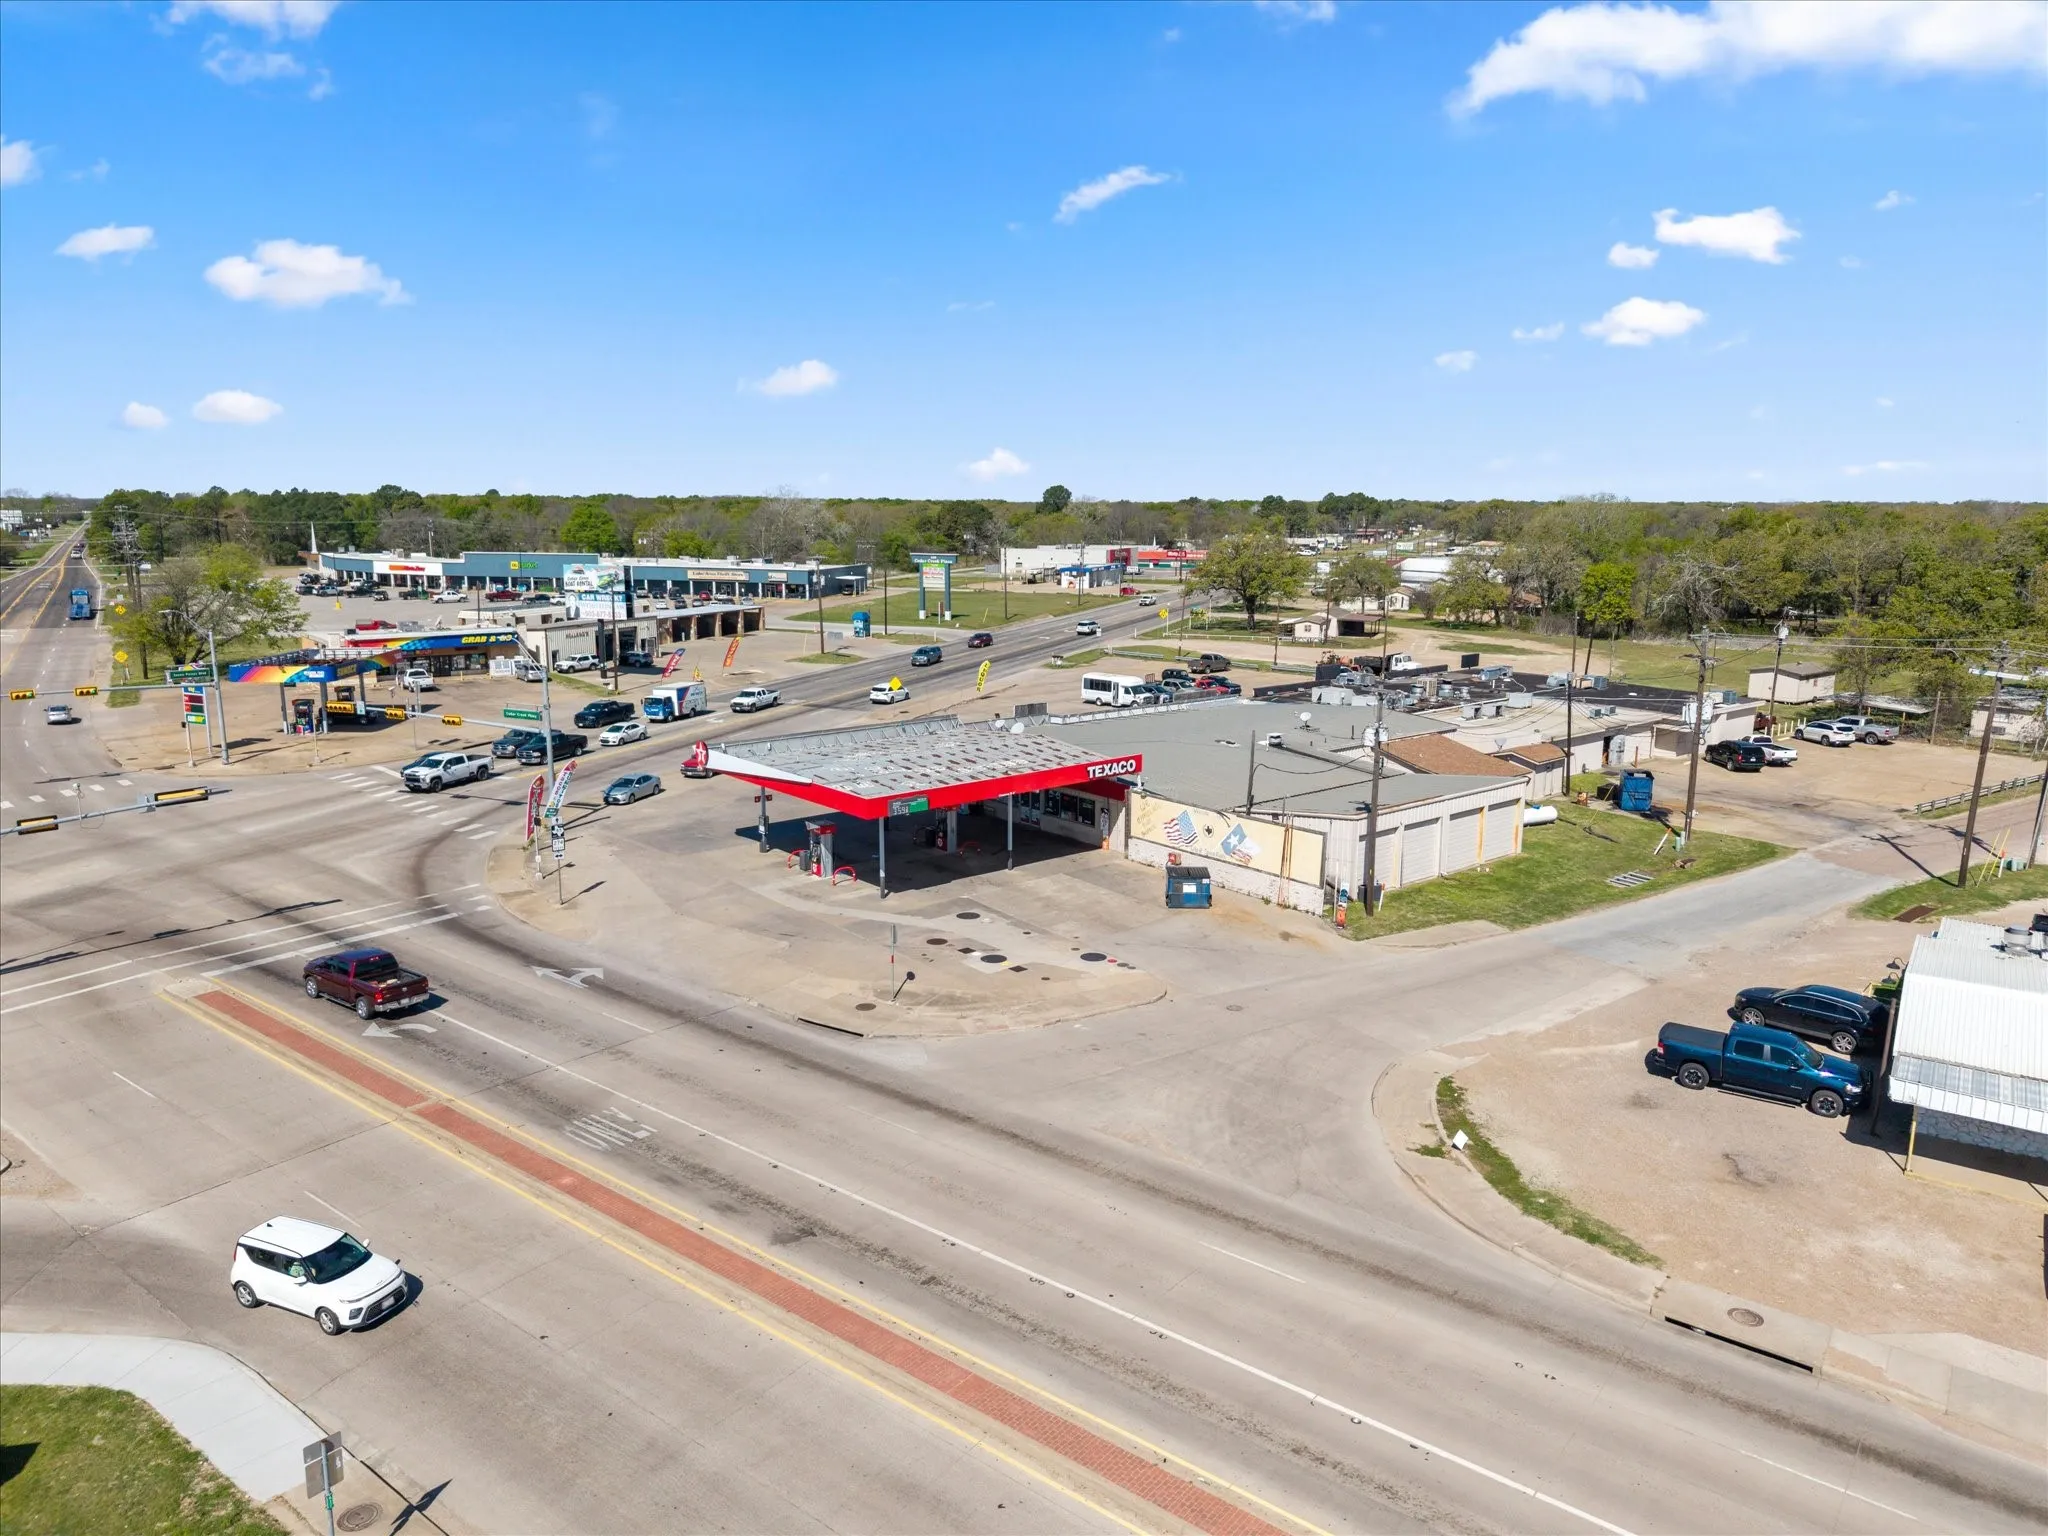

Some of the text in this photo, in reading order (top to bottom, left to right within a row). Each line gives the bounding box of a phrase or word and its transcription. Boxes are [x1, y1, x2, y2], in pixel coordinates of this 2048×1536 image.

[462, 635, 487, 644] GRAB
[1087, 759, 1136, 778] TEXACO
[563, 1106, 657, 1151] ONLY
